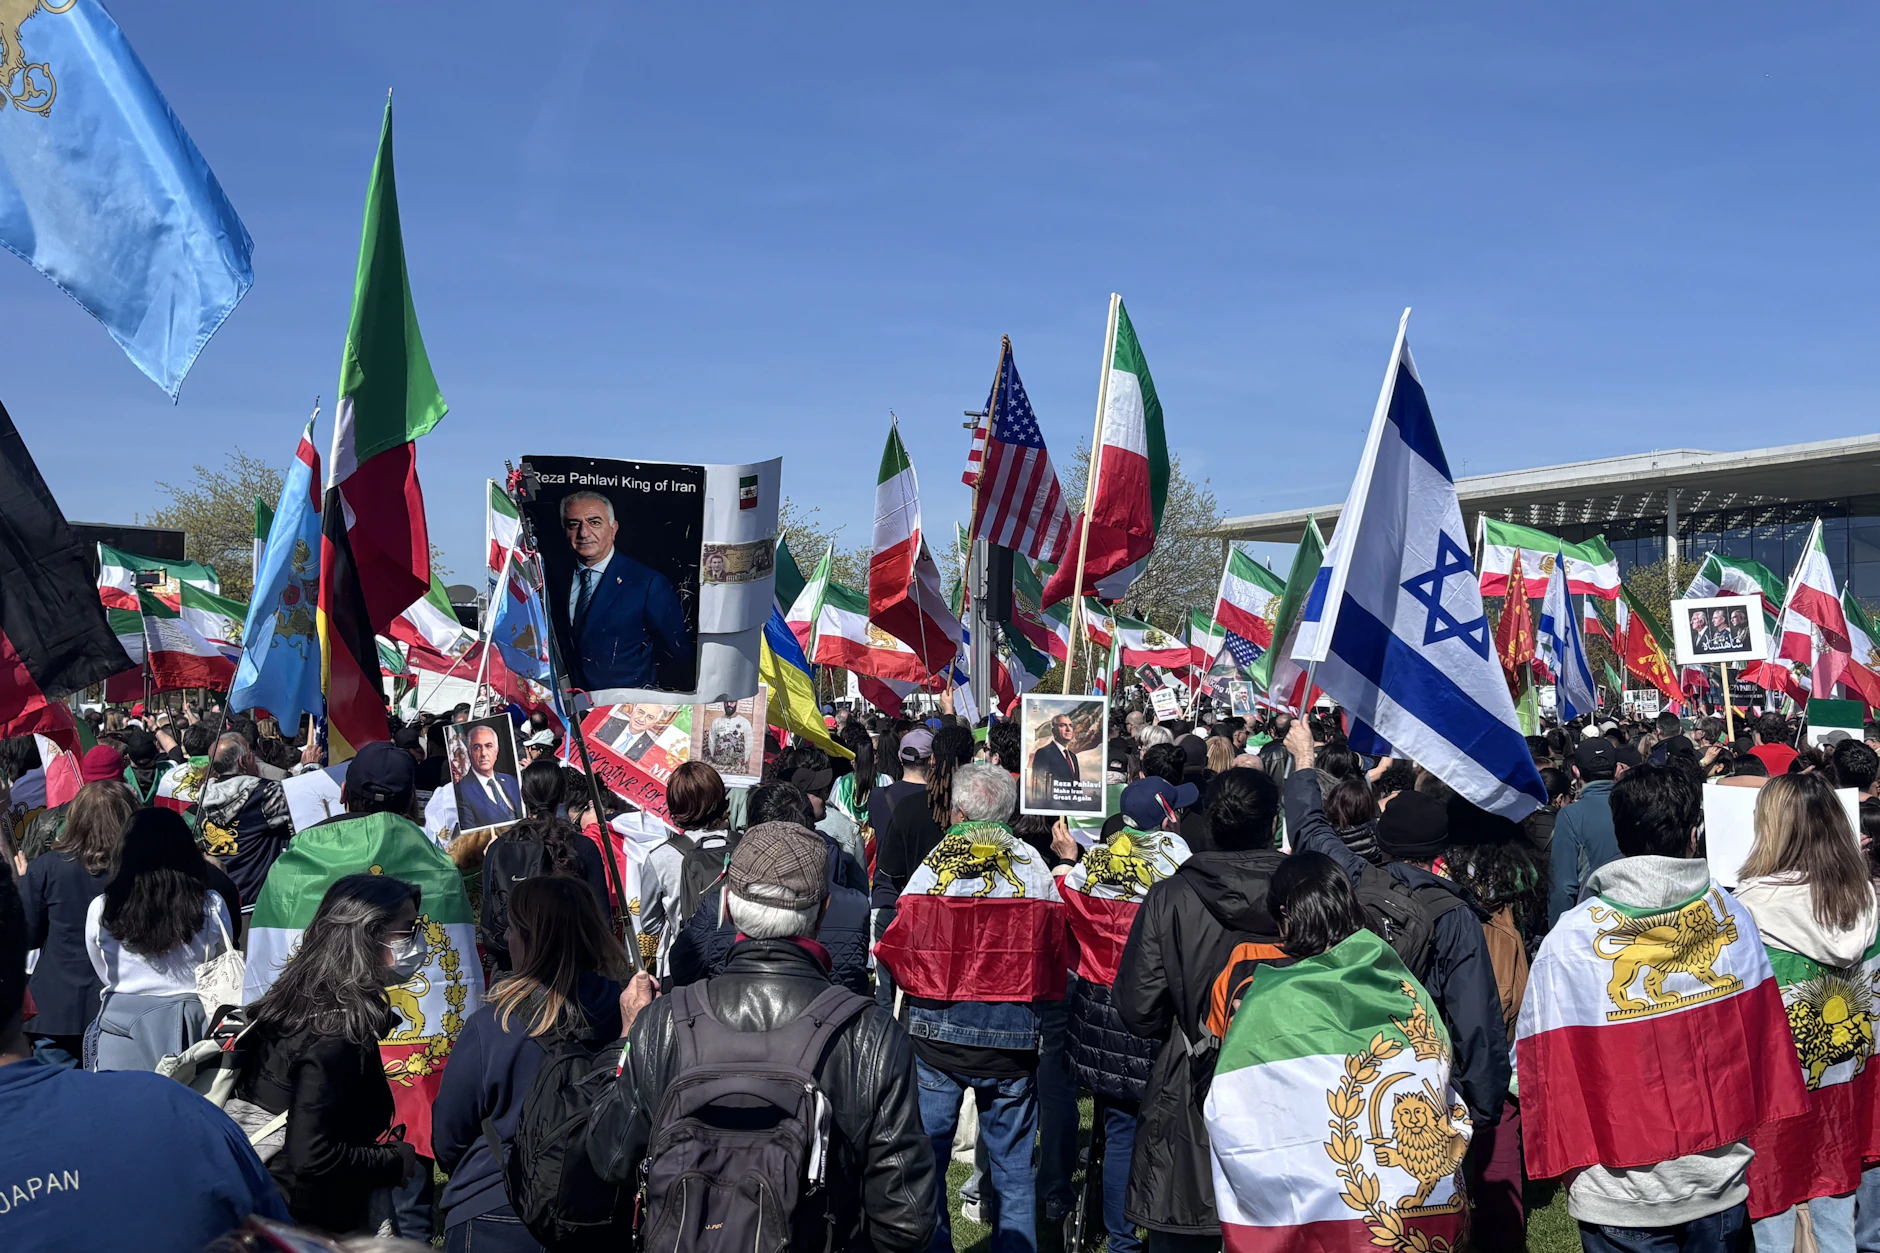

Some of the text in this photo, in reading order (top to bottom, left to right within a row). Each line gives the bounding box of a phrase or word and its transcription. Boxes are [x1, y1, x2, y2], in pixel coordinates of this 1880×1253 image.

[533, 471, 696, 492] Reza Pahlavi King of Iran
[1210, 680, 1224, 693] King
[638, 782, 664, 801] for
[1073, 780, 1101, 788] Pahlavi
[0, 1169, 79, 1213] JAPAN
